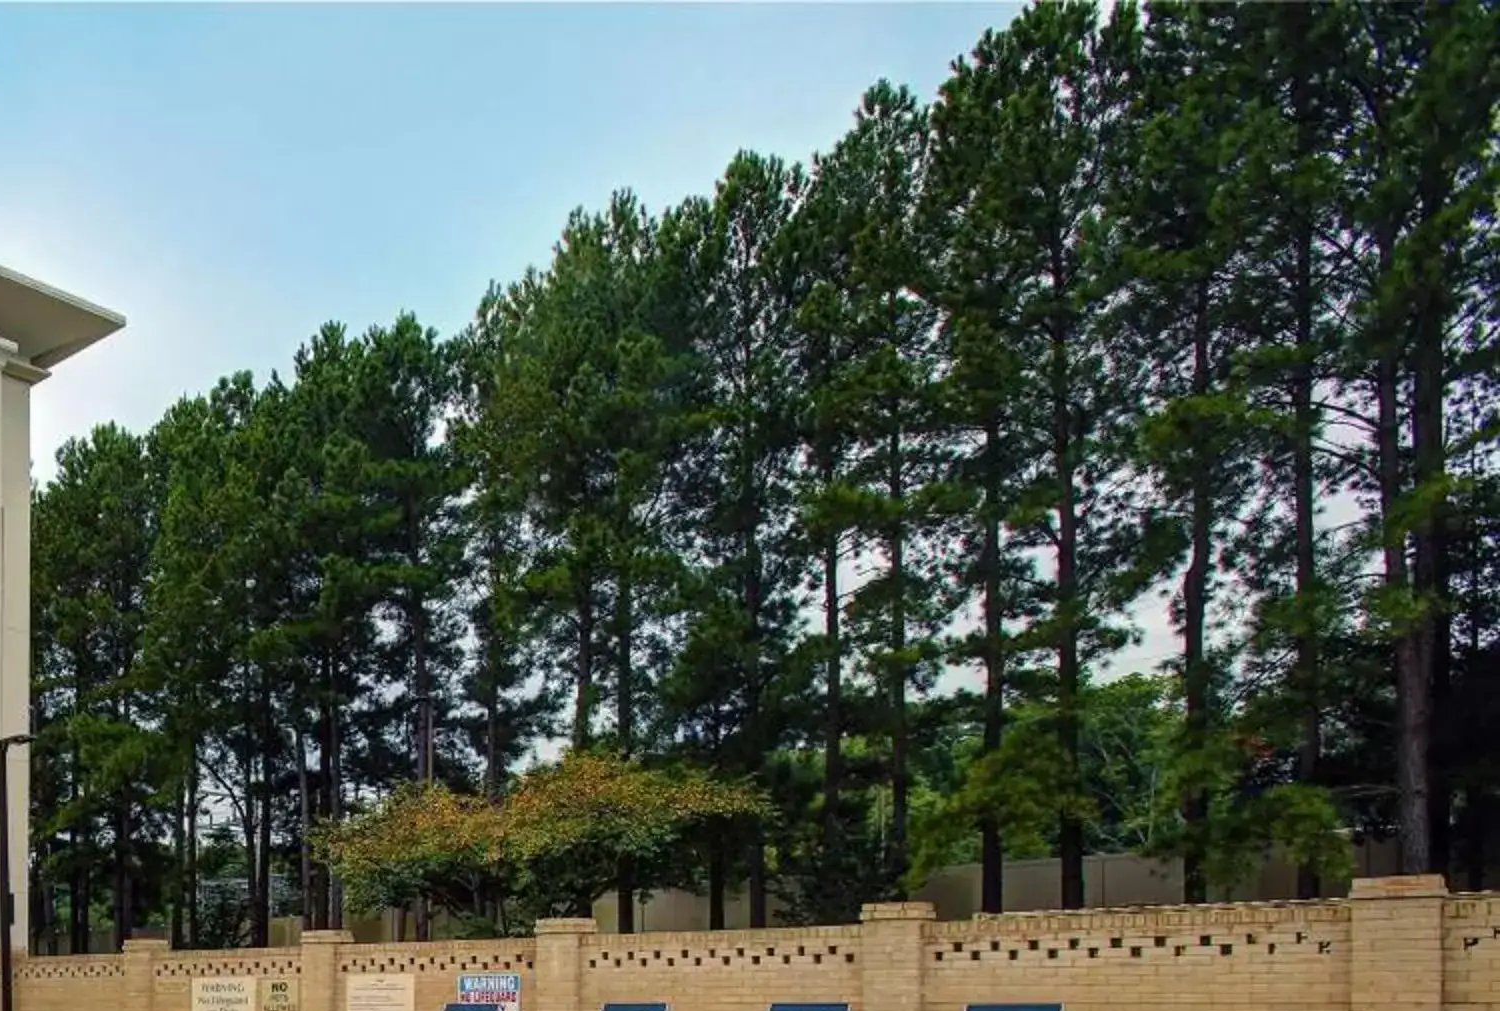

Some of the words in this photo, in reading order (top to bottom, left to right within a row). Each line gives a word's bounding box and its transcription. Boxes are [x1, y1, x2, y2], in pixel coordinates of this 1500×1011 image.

[201, 983, 245, 993] WARNING
[271, 982, 289, 992] NO
[463, 976, 515, 990] WARNING
[473, 991, 516, 1002] LIFEGUARD
